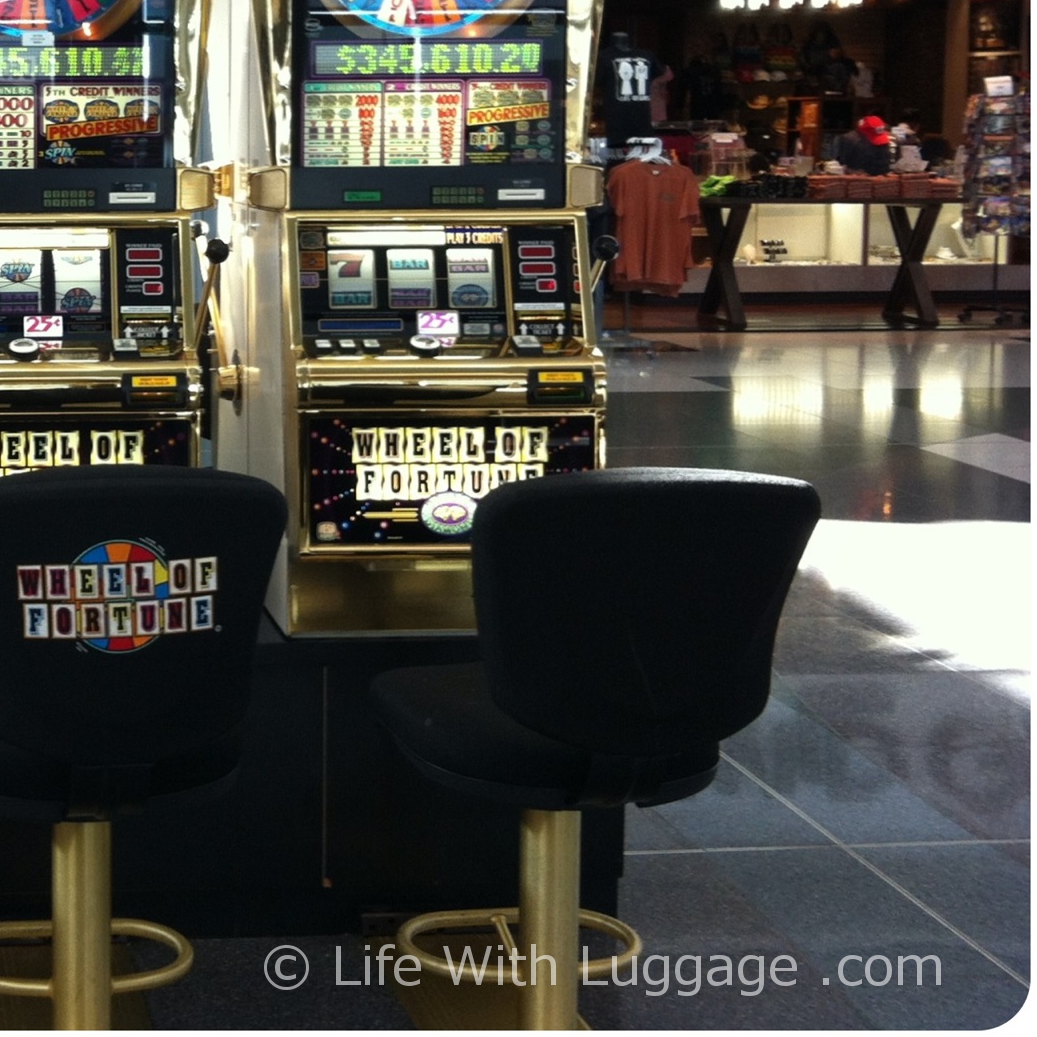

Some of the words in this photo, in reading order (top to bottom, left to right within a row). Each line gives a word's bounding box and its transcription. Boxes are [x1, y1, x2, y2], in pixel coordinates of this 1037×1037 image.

[69, 86, 110, 97] CREDIT
[113, 86, 160, 97] WINNERS
[468, 104, 549, 125] PROGRESSIVE
[49, 117, 158, 139] PROGRESSIVE
[469, 132, 505, 145] SPIN
[44, 147, 78, 160] SPIN
[21, 160, 30, 168] 2
[0, 262, 35, 278] SPIN
[394, 260, 429, 269] BAR
[453, 265, 488, 273] BAR
[60, 295, 96, 311] SPIN
[26, 316, 62, 333] 25¢
[419, 311, 456, 329] 25¢
[90, 431, 145, 465] OF
[352, 428, 485, 463] WHEEL
[494, 427, 549, 462] OF
[17, 562, 155, 600] WHEEL
[168, 557, 218, 595] OF
[23, 595, 214, 639] FORTUNE
